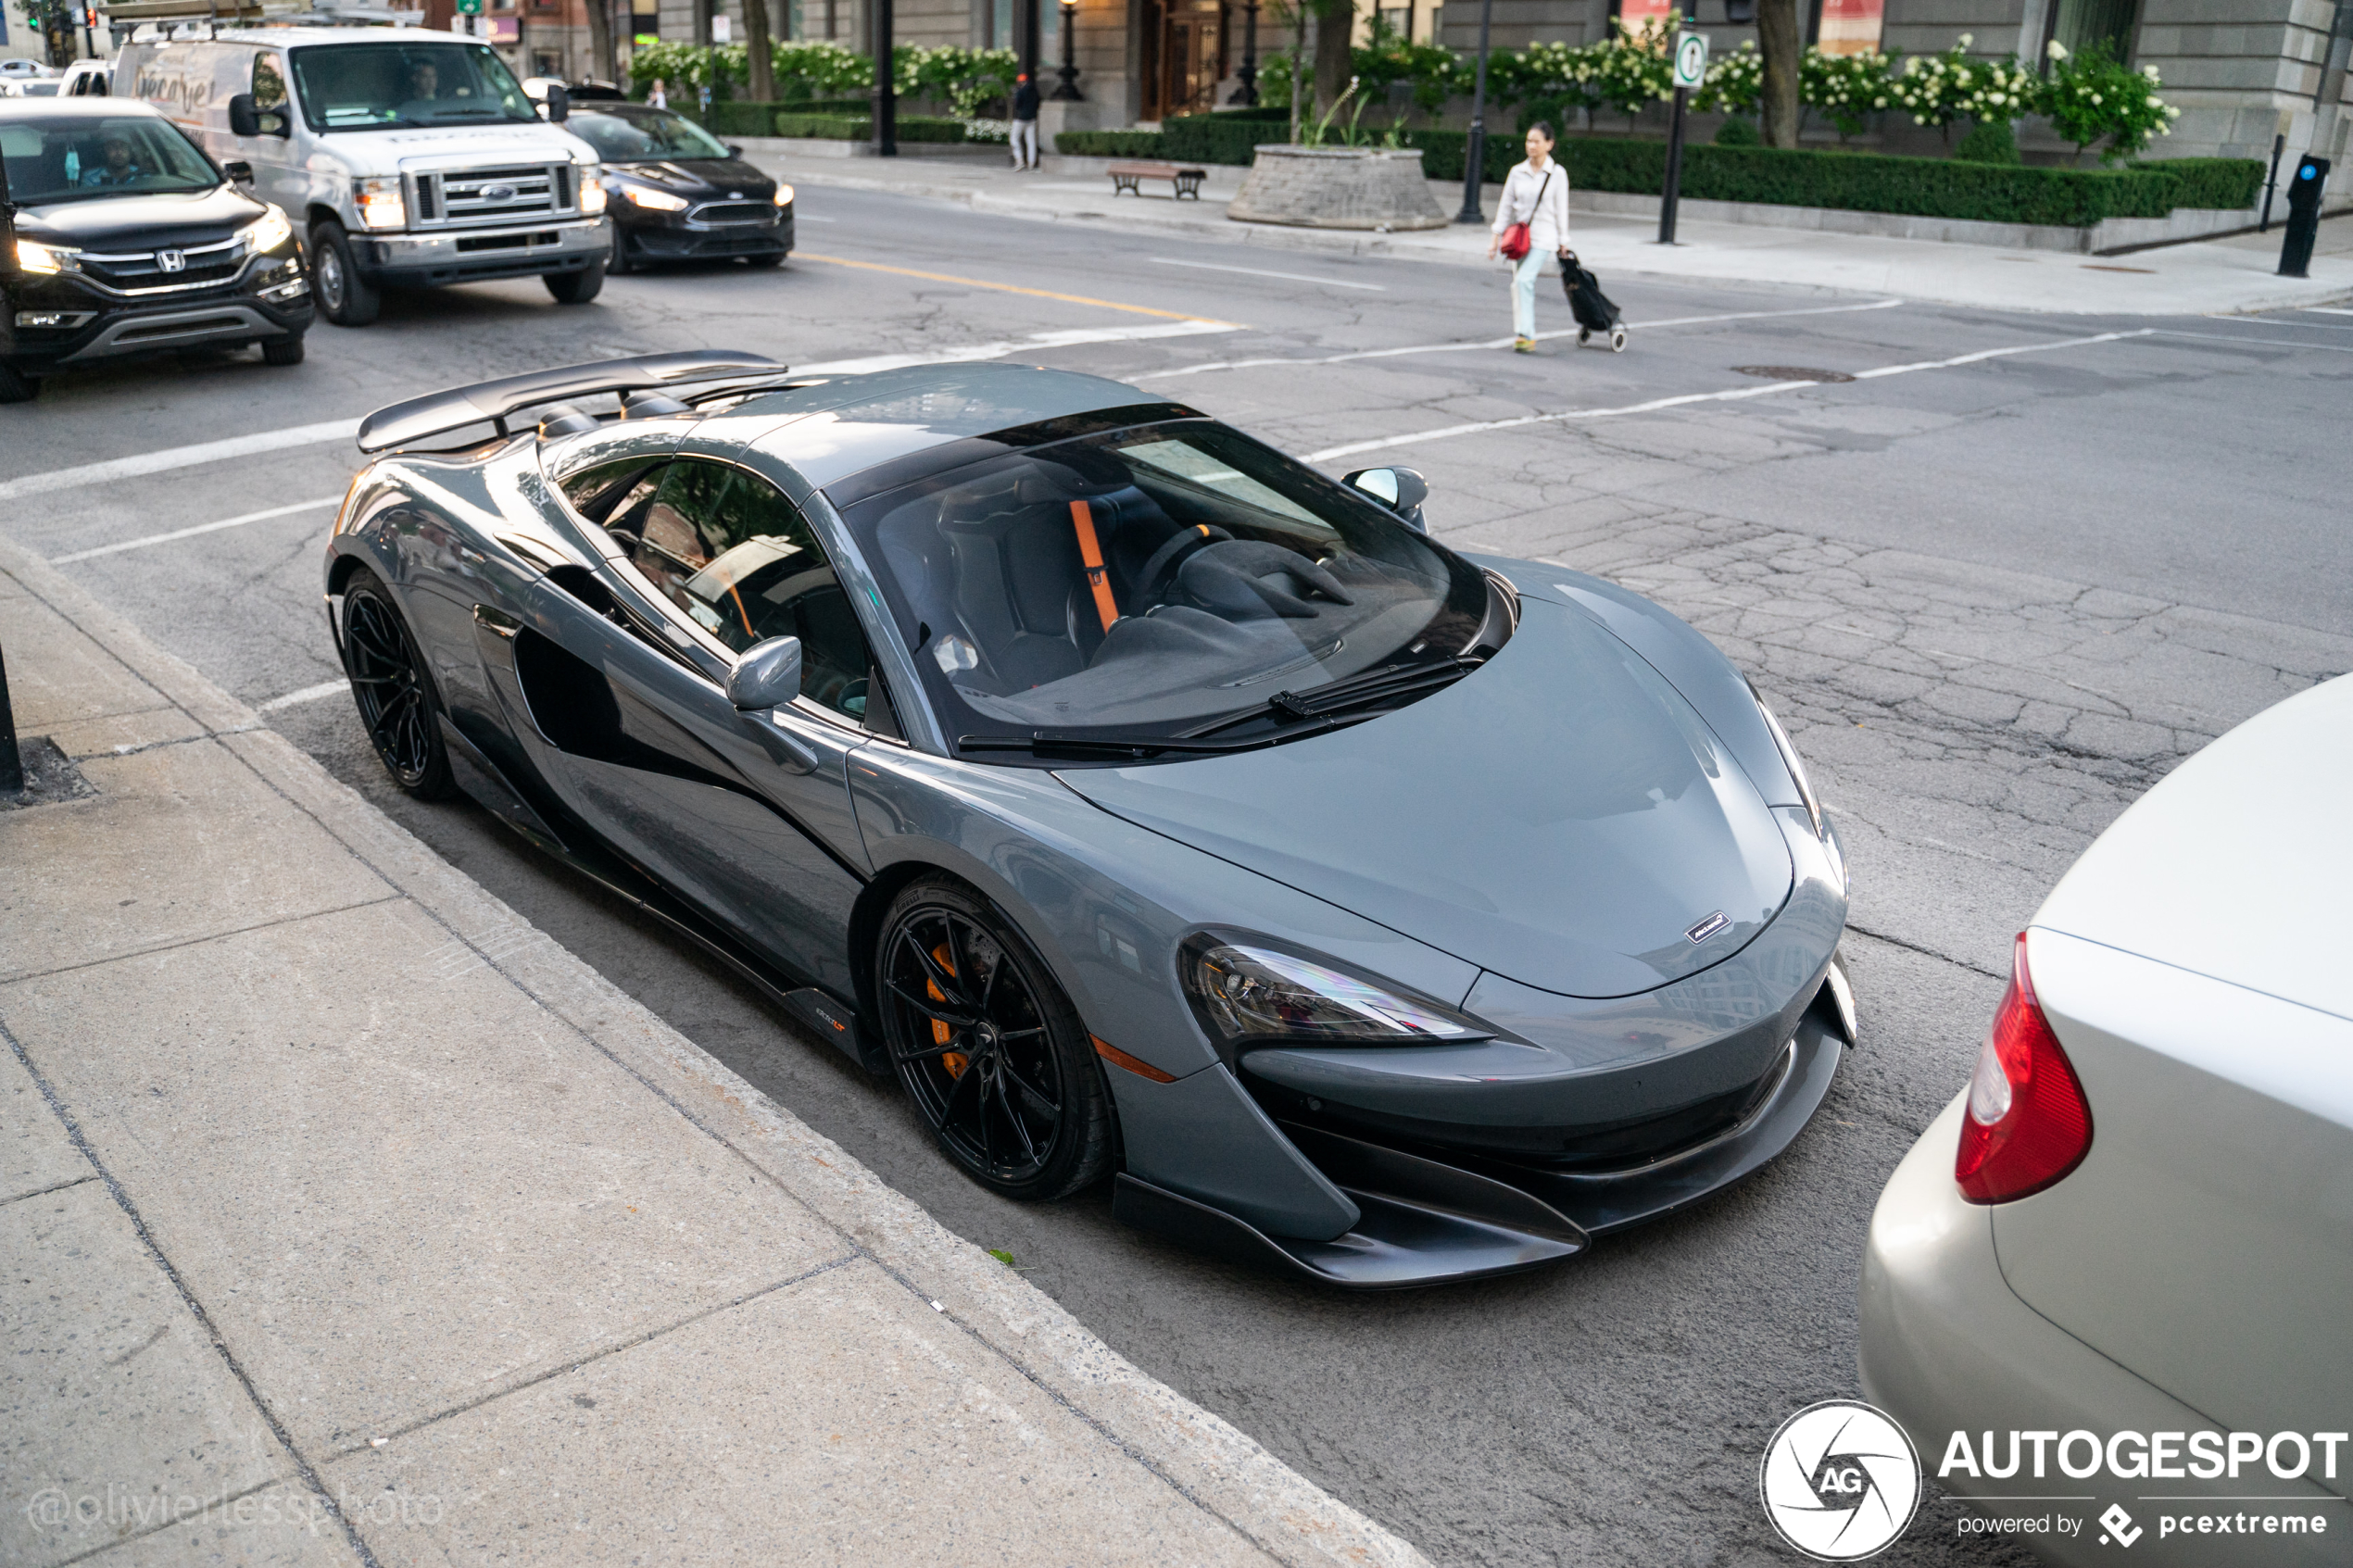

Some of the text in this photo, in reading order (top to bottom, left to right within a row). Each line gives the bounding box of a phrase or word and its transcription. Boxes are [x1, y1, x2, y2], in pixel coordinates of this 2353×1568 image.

[896, 889, 920, 914] PIRELLI
[1694, 920, 1724, 939] McLaren
[815, 1007, 846, 1033] 600LT
